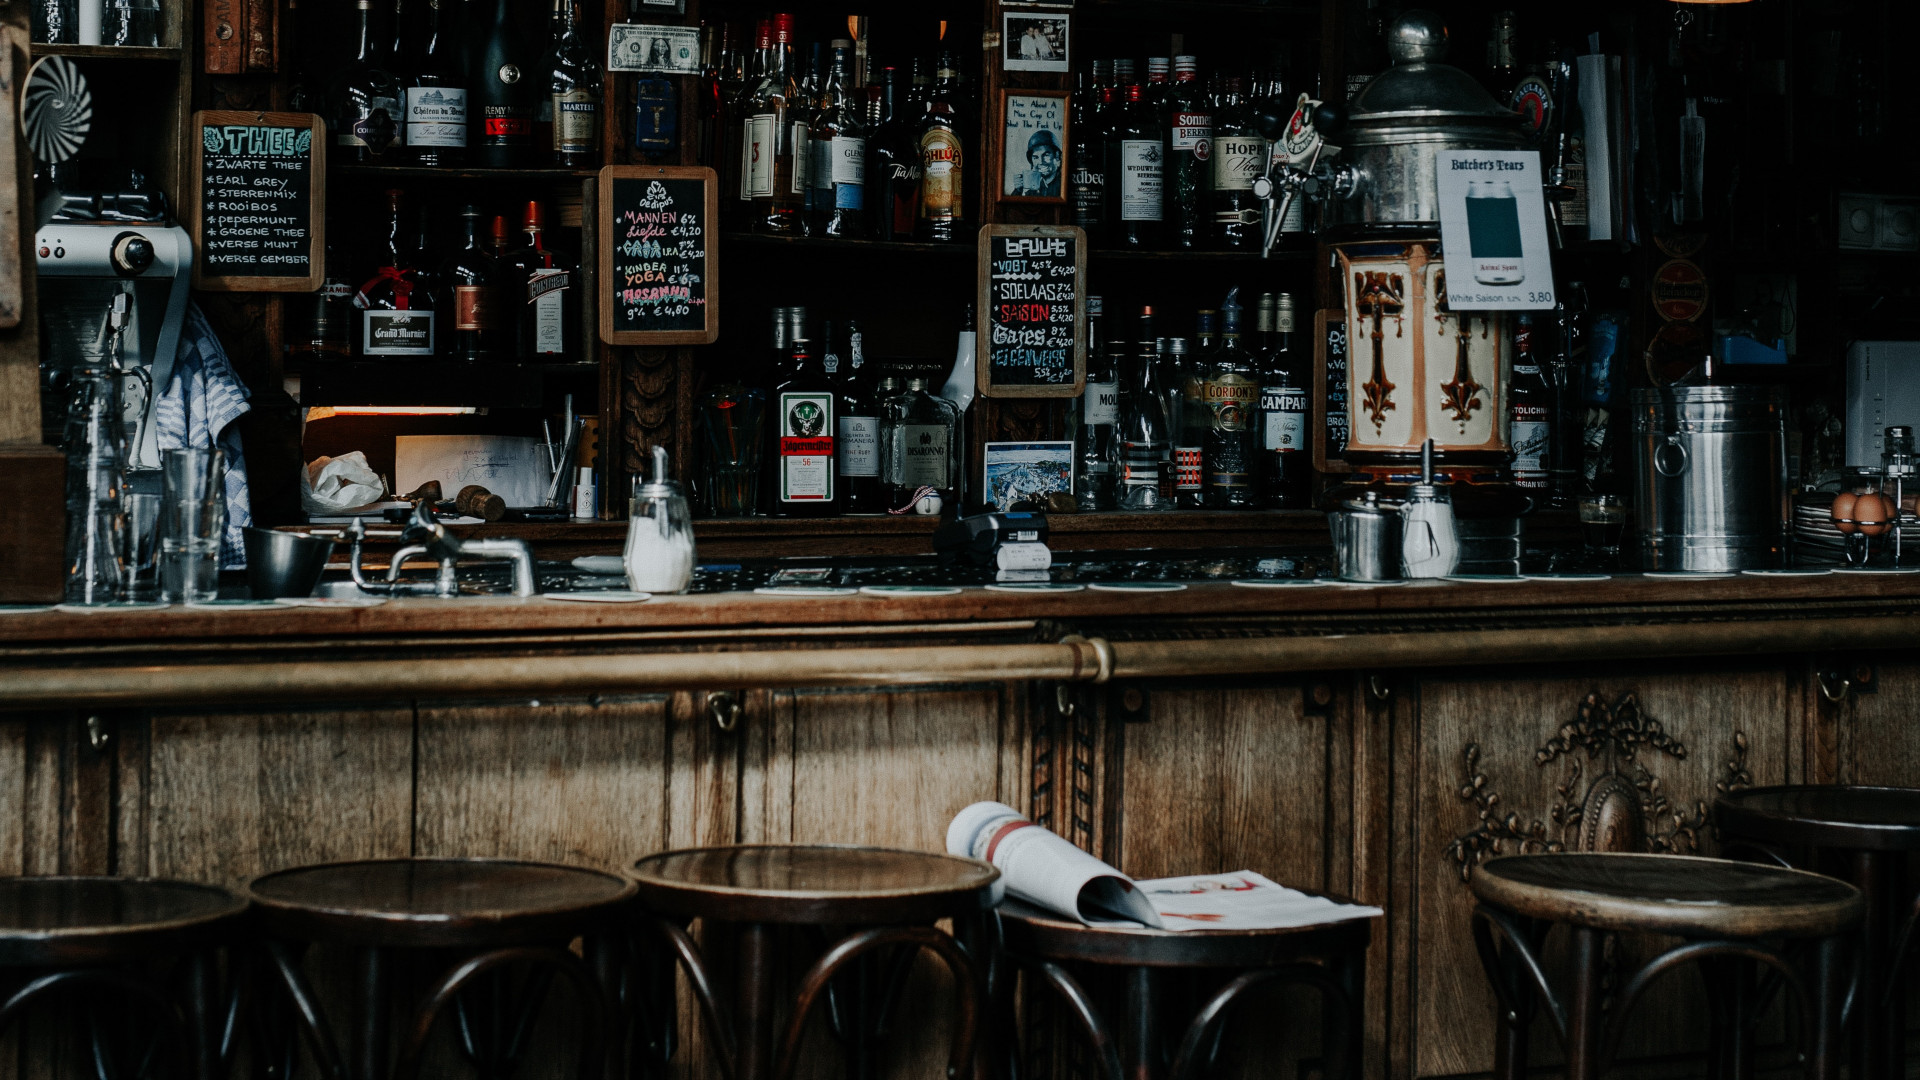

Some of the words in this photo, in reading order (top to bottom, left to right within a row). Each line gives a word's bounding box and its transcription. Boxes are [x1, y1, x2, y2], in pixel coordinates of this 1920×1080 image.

[562, 103, 595, 111] MARTELL
[1014, 110, 1026, 118] Nice
[1046, 110, 1055, 119] Of
[1022, 120, 1032, 128] The
[1053, 121, 1062, 130] Up
[223, 126, 296, 156] THEE
[216, 159, 267, 170] ZWARTE
[272, 161, 302, 170] THEE
[1451, 159, 1494, 171] Butcher's
[1496, 160, 1524, 171] Tears
[216, 175, 248, 186] EARL
[254, 178, 288, 191] GREY
[639, 196, 674, 212] Oedipus
[624, 210, 677, 224] MANNEN
[680, 212, 697, 225] 6%
[220, 228, 270, 236] GROENE
[274, 228, 306, 237] THEE
[670, 226, 702, 238] €4,20
[218, 240, 258, 248] VERSE
[264, 241, 299, 249] MUNT
[218, 255, 257, 264] VERSE
[260, 255, 310, 264] GEMBER
[624, 262, 667, 276] KINDER
[998, 260, 1028, 273] VOGT
[1050, 266, 1076, 277] €4,20
[624, 270, 665, 287] YOGA
[1449, 294, 1474, 302] White
[1476, 294, 1504, 302] Saison
[1528, 292, 1552, 304] 3,80
[1050, 313, 1074, 323] €4,20
[375, 328, 398, 339] Grand
[398, 328, 427, 339] Marnier
[1210, 384, 1254, 398] GORDON'S
[908, 446, 944, 456] DISARONNO
[802, 458, 811, 466] 56
